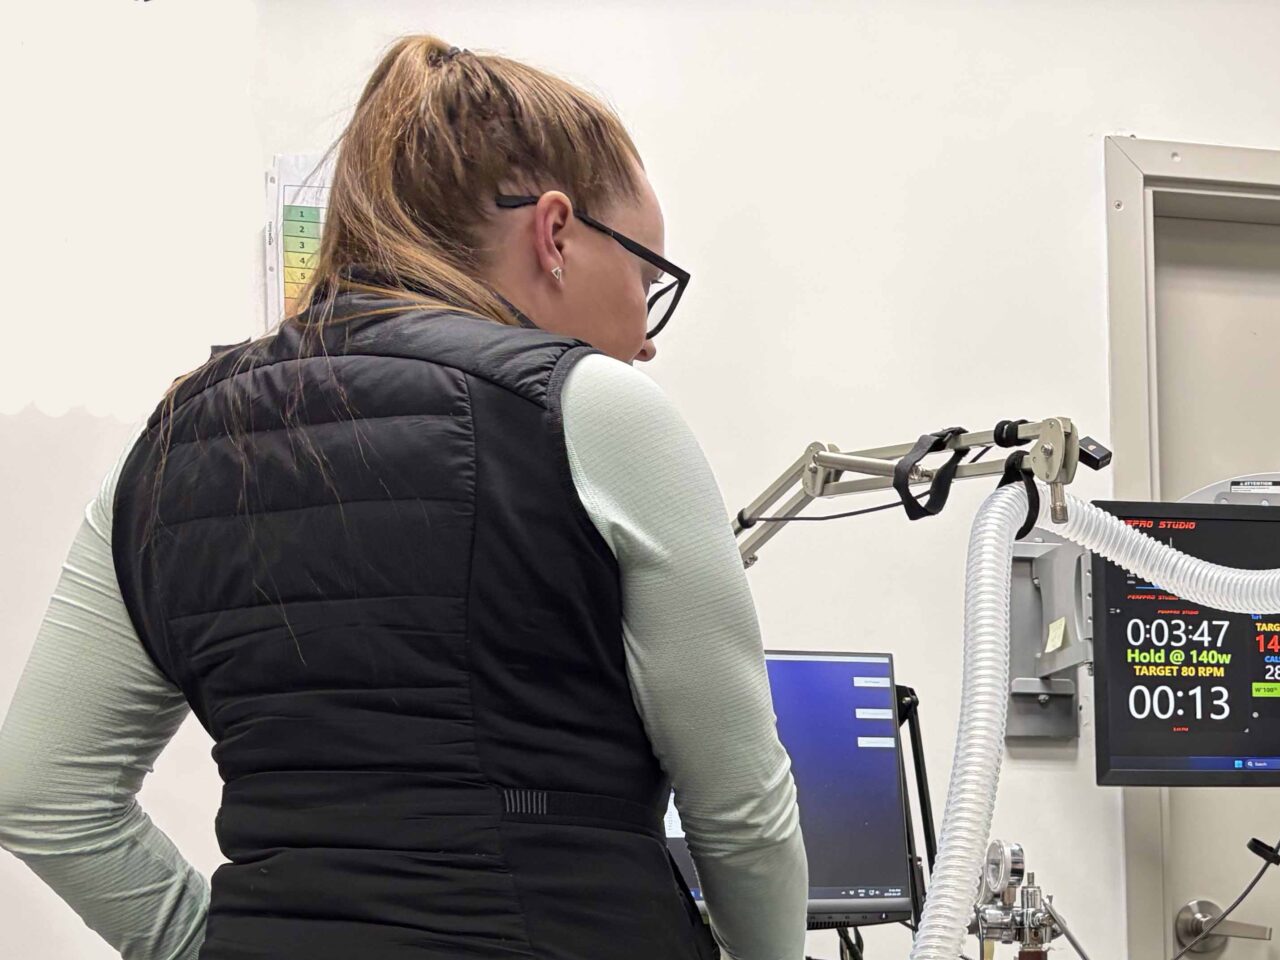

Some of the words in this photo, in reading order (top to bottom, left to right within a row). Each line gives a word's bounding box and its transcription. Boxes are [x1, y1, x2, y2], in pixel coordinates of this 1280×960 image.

[1158, 520, 1196, 529] STUDIO
[1126, 618, 1230, 648] 0:03:47
[1127, 649, 1165, 663] Hold
[1169, 649, 1185, 665] @
[1189, 650, 1231, 664] 140w
[1133, 665, 1179, 676] TARGET
[1181, 666, 1196, 676] 80
[1198, 667, 1225, 677] RPM
[1128, 684, 1231, 720] 00:13
